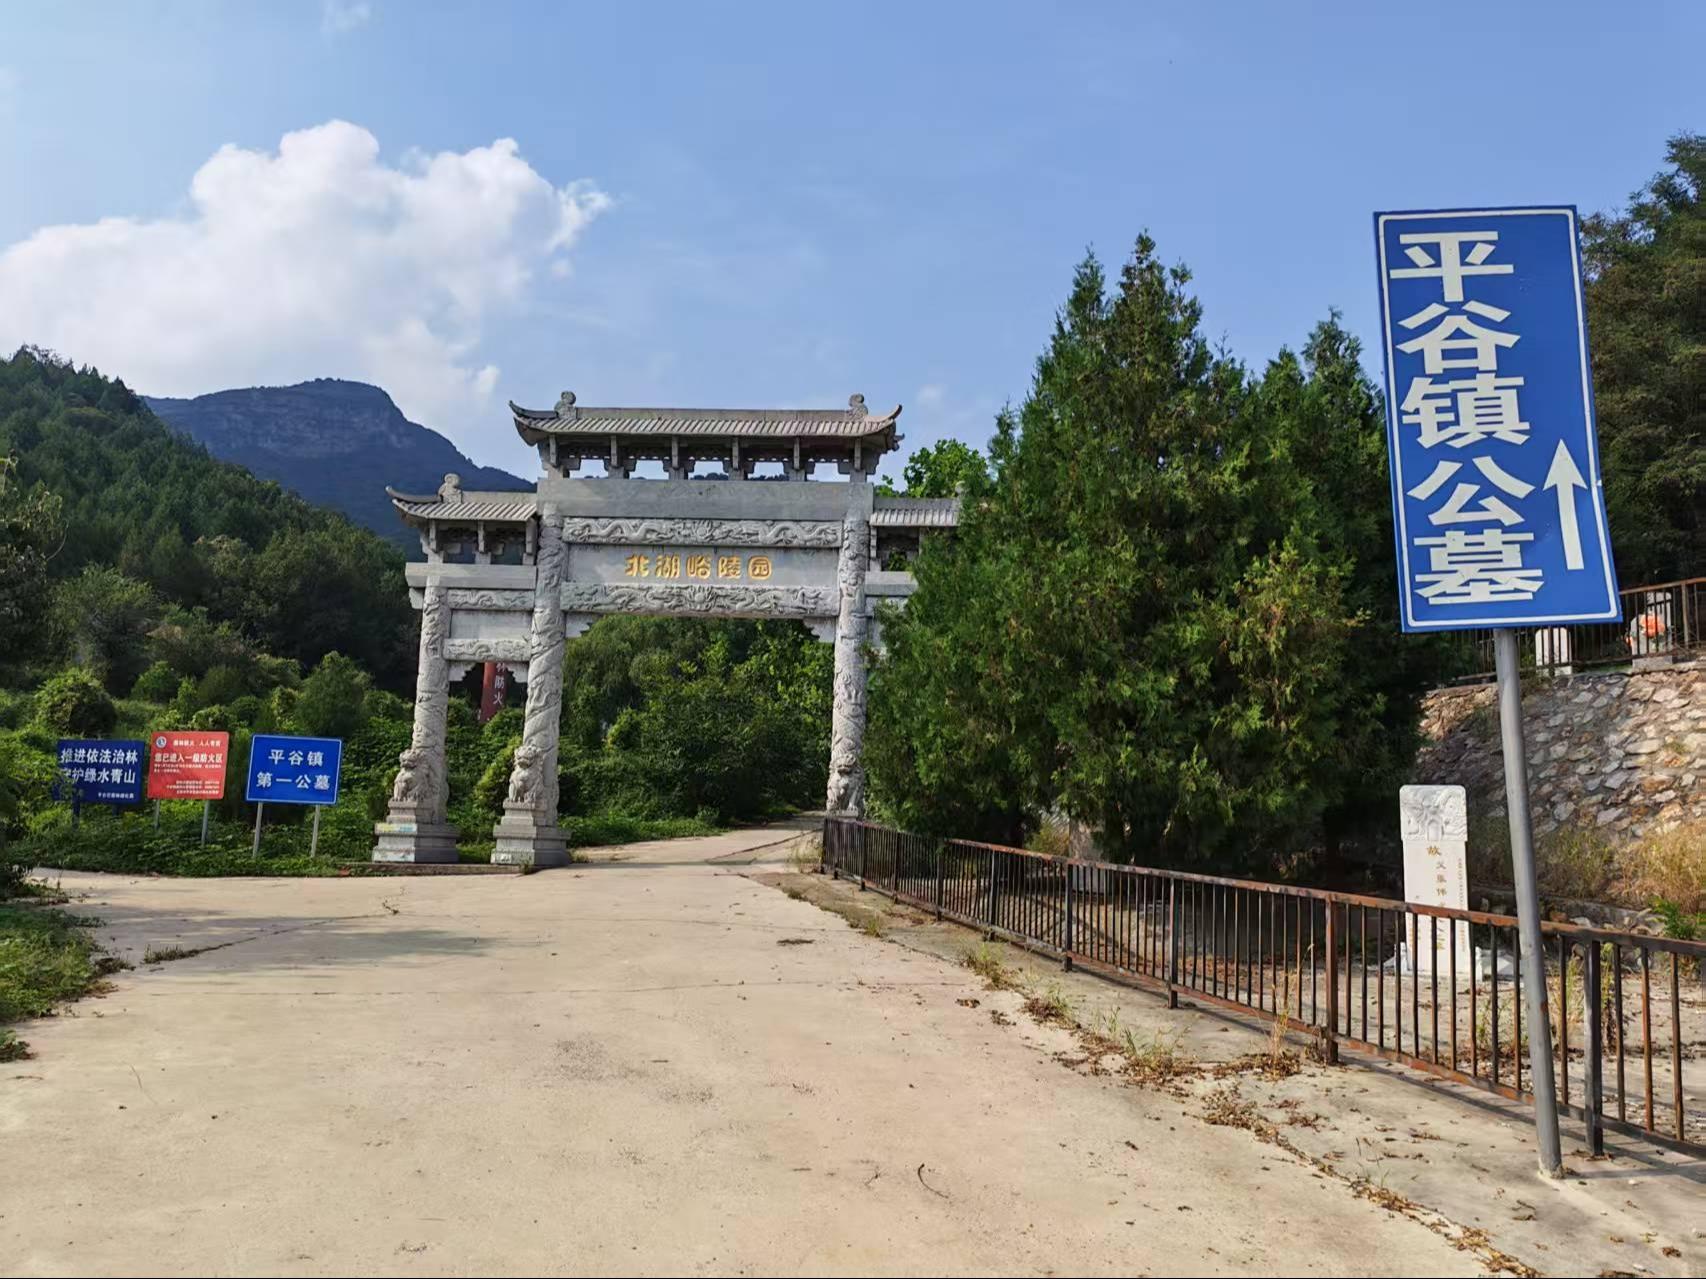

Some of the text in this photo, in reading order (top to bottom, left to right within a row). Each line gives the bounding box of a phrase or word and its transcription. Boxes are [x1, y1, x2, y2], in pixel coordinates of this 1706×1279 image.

[1389, 230, 1545, 606] 平谷镇公墓
[625, 554, 773, 580] 北湖峪陵园
[60, 747, 139, 765] 推进依法治林
[268, 749, 324, 767] 平谷镇
[256, 771, 331, 790] 第一公墓
